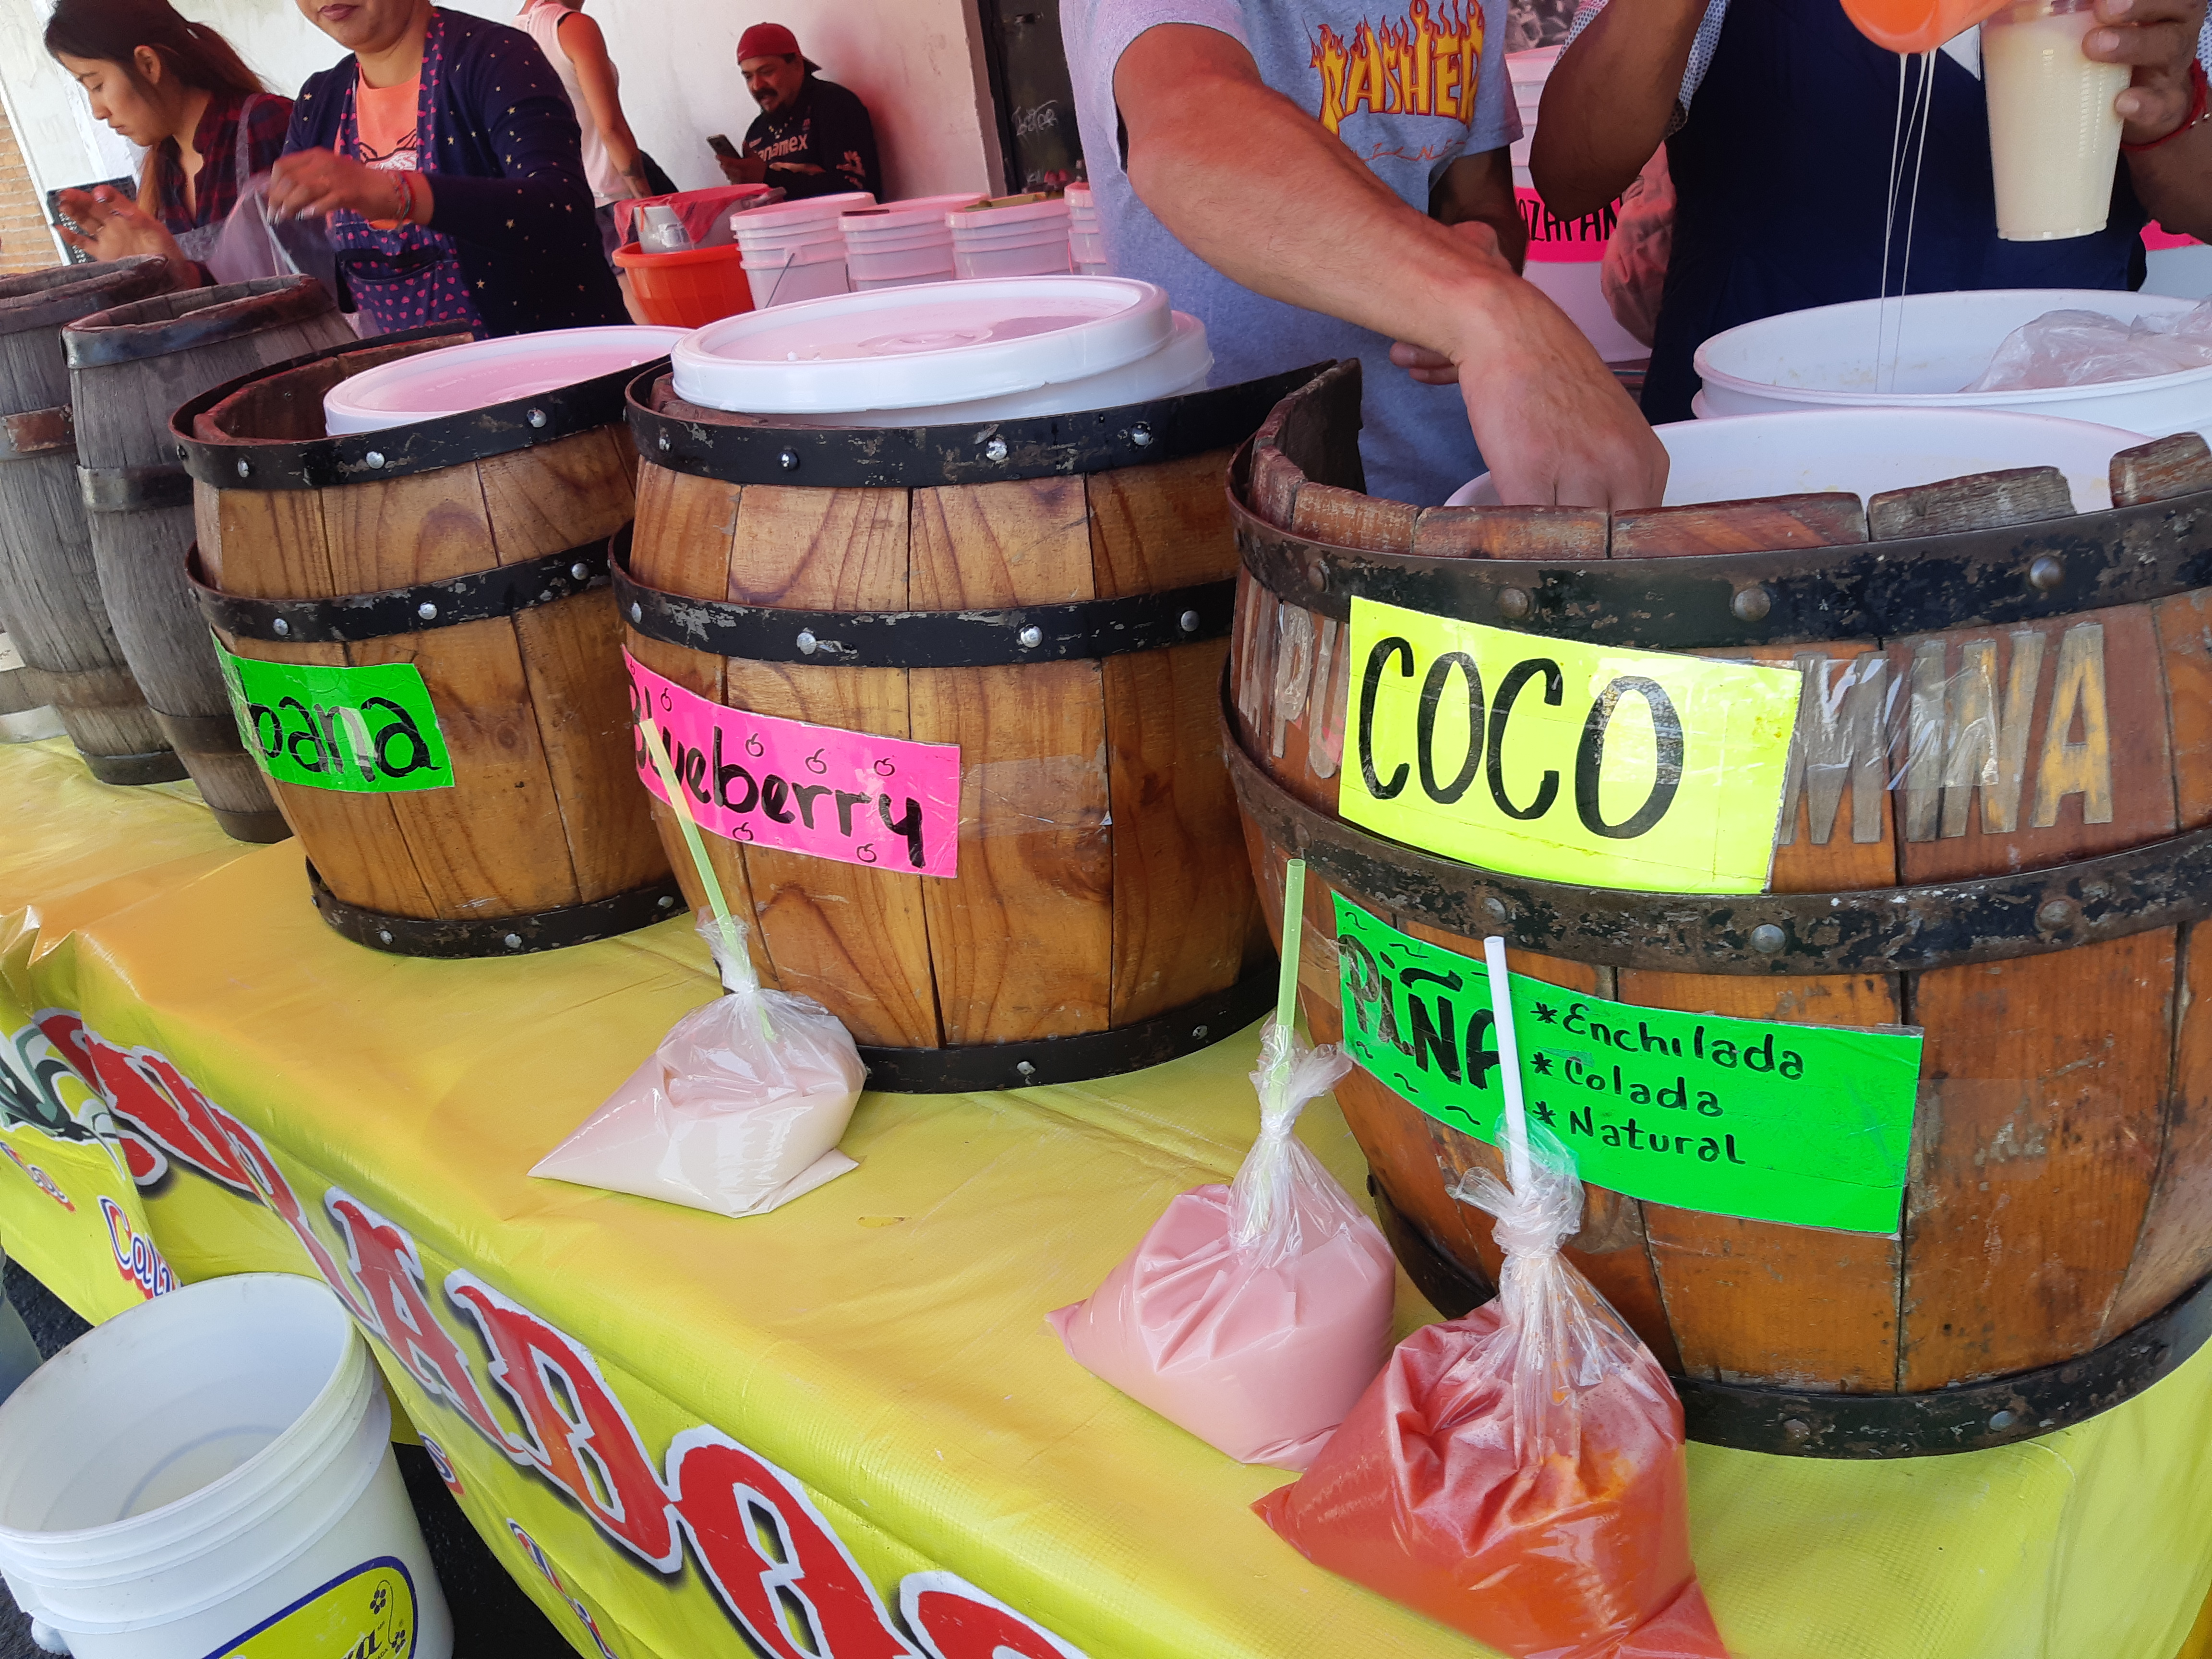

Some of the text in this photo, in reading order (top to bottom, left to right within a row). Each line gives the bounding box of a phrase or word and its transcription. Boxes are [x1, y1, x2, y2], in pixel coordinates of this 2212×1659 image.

[754, 133, 808, 161] anamex
[1358, 637, 1684, 840] COCO
[1778, 623, 2113, 845] MINA
[1562, 1003, 1804, 1080] Enchilada
[1564, 1056, 1724, 1117] Colada
[1569, 1106, 1746, 1165] Natural
